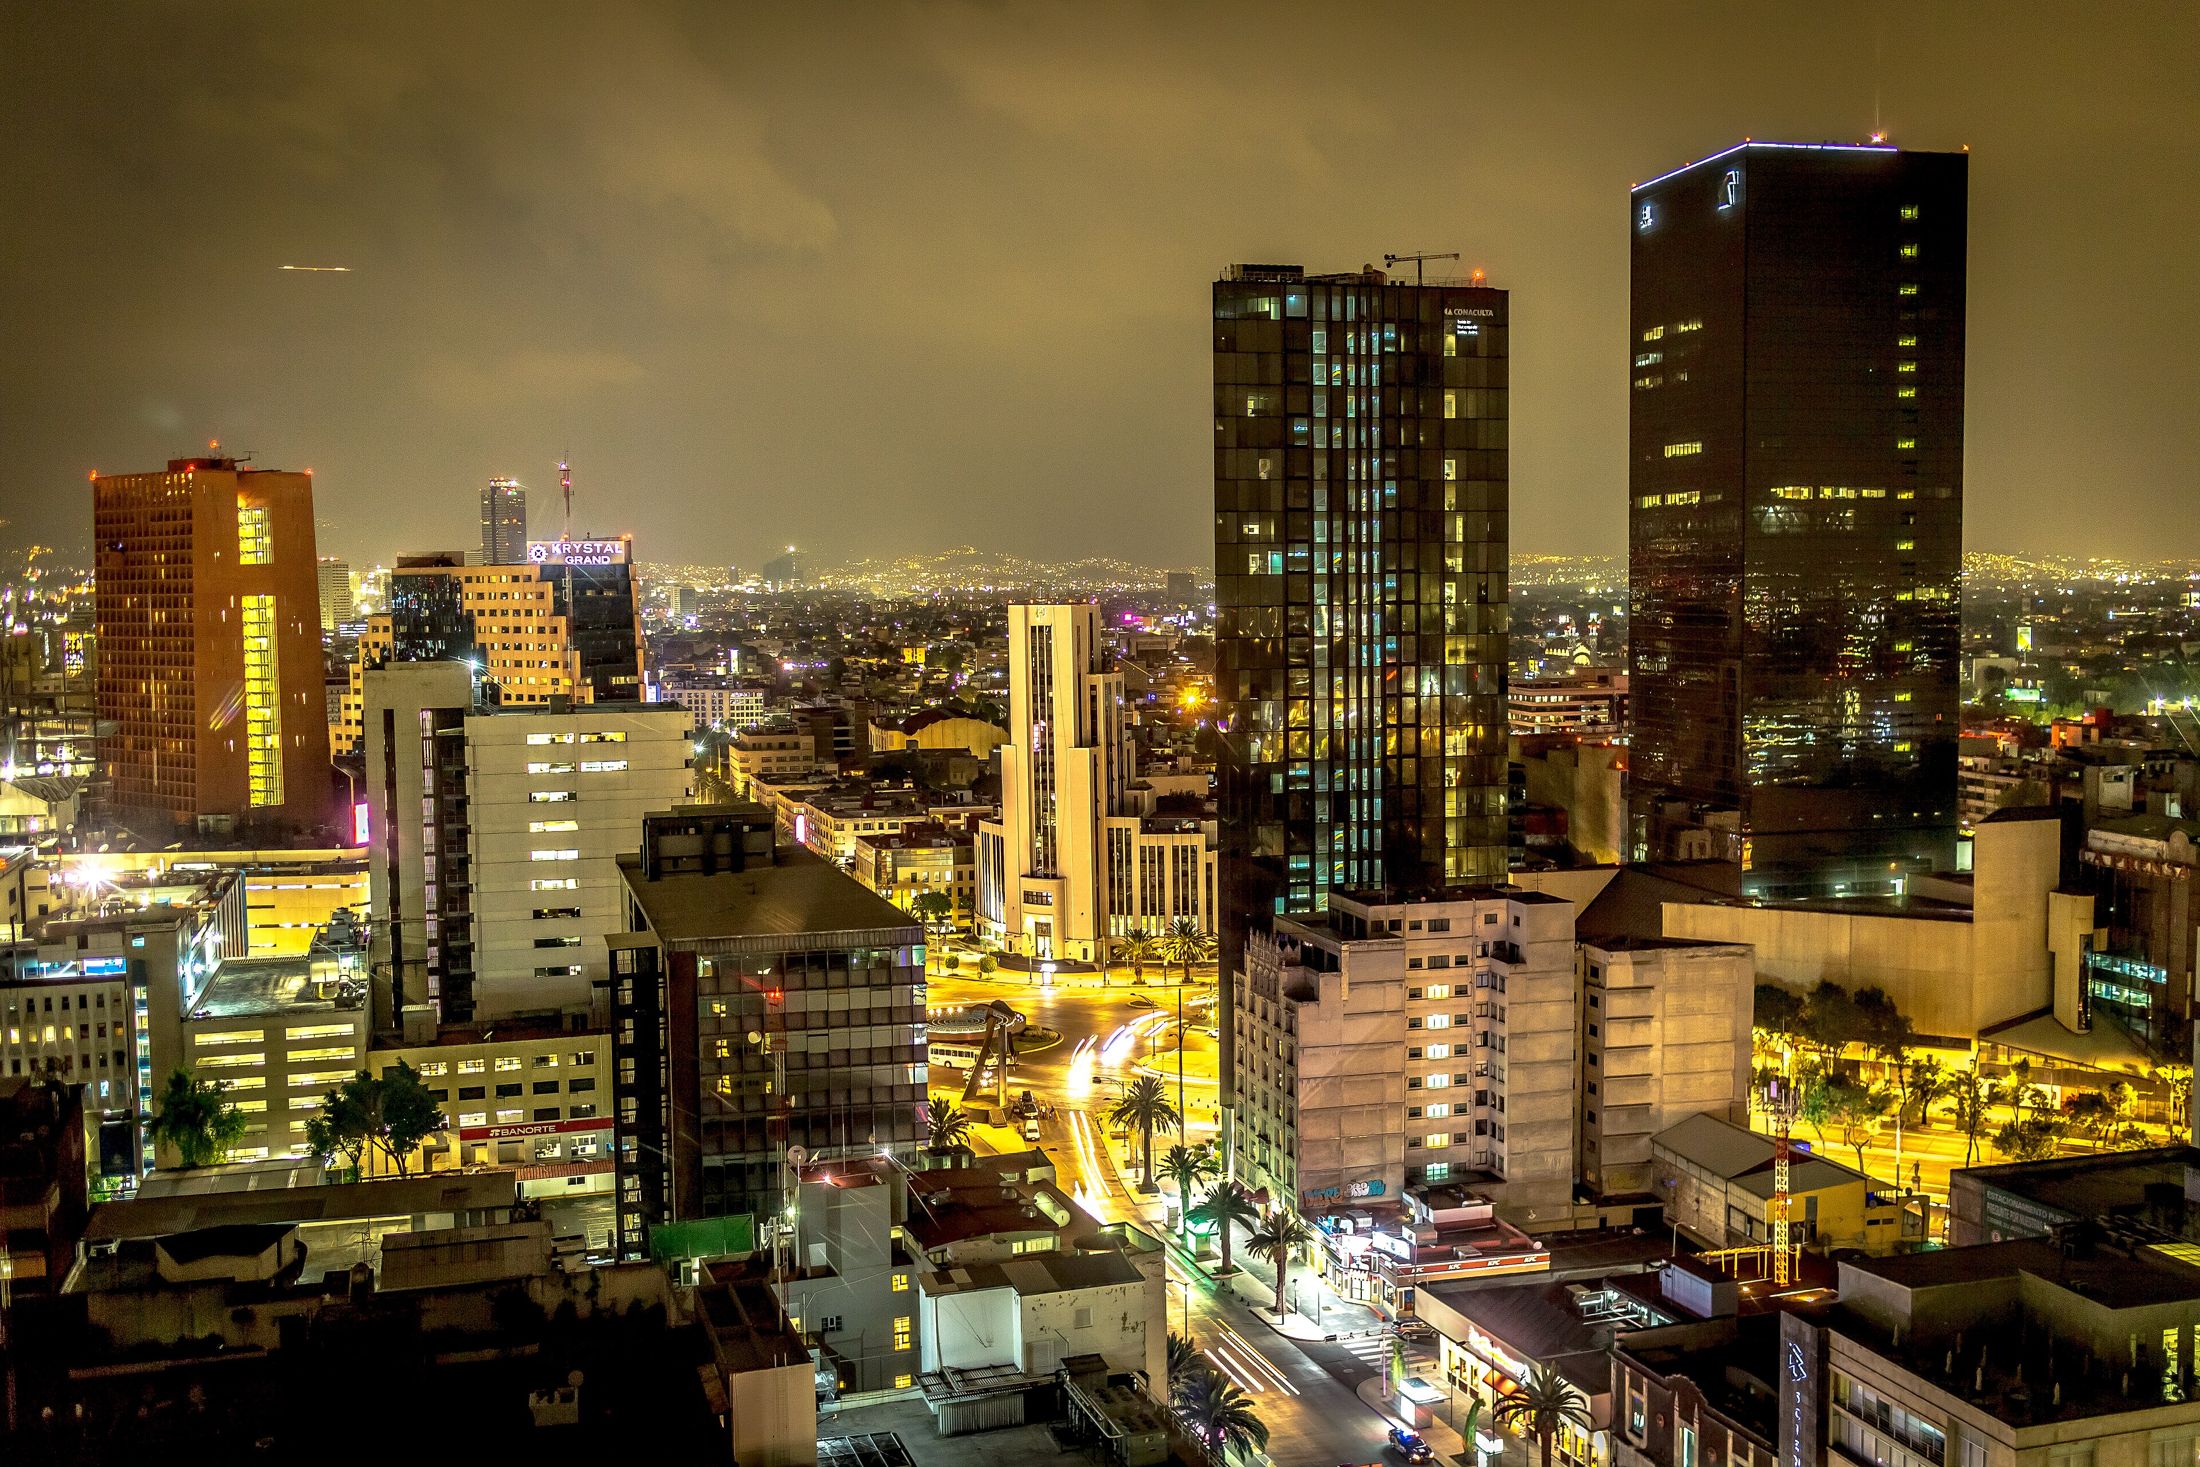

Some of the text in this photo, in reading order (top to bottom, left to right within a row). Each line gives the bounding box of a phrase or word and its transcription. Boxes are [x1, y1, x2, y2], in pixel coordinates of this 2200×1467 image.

[1454, 308, 1494, 317] CONACULTA
[551, 543, 623, 554] KRYSTAL
[565, 555, 611, 565] GRAND
[500, 1125, 556, 1137] BANORTE
[1986, 1190, 2048, 1219] ESTACIONAMIENTO
